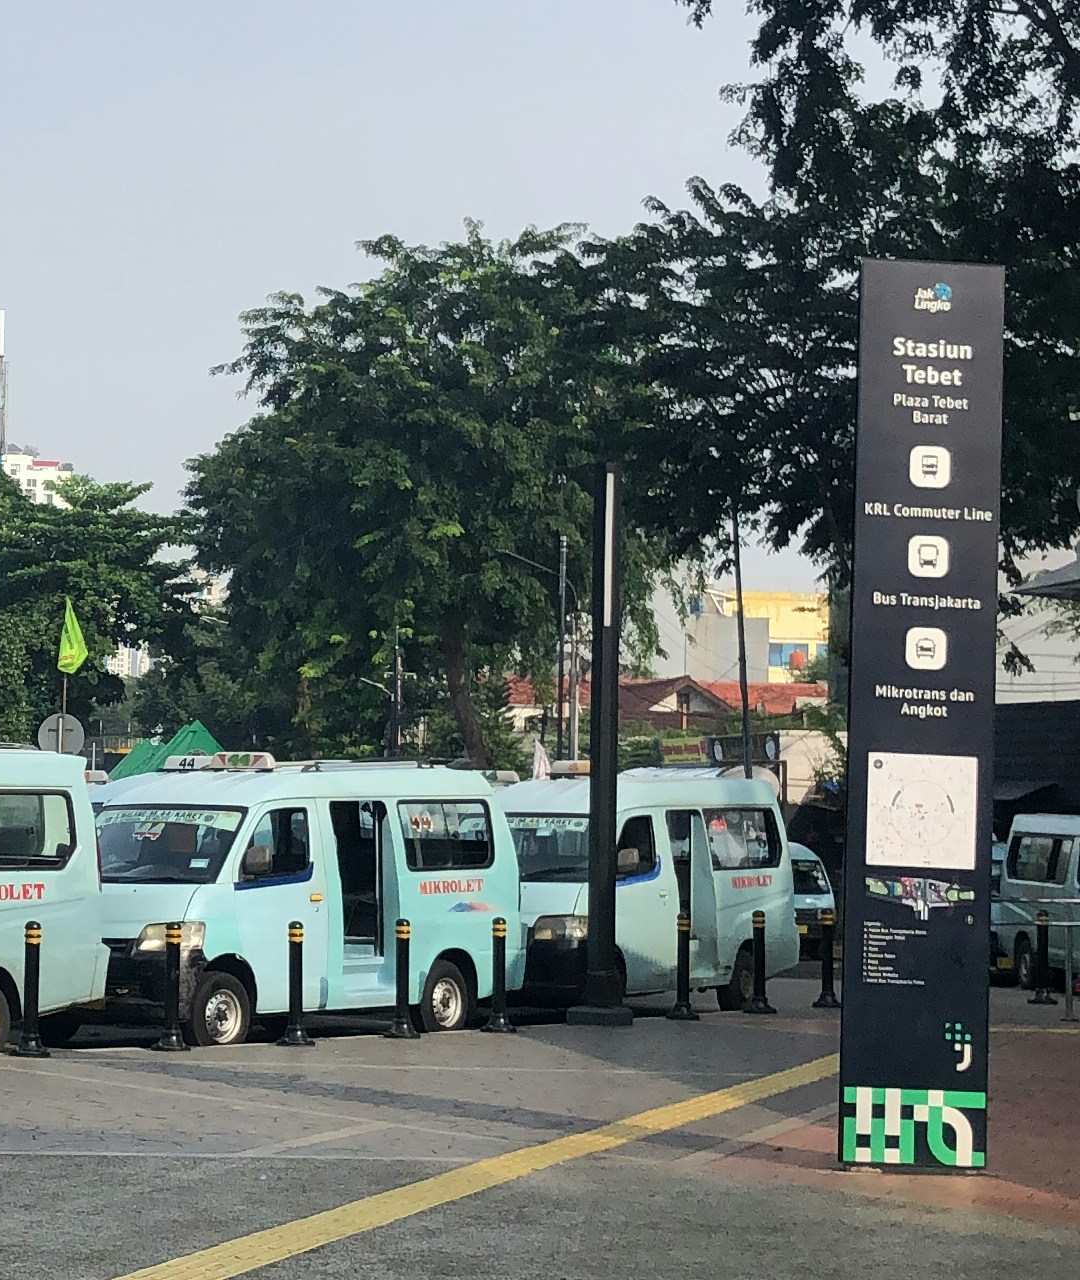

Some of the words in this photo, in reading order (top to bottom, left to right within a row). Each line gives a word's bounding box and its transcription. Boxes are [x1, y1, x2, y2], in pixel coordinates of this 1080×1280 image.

[914, 300, 951, 313] Lingko
[893, 337, 972, 359] Stasiun
[902, 364, 962, 386] Tebet
[894, 393, 929, 407] Plaza
[932, 395, 968, 409] Tebet
[913, 411, 949, 424] Barat
[865, 503, 890, 515] KRL
[894, 504, 961, 519] Commuter
[964, 507, 992, 521] Line
[874, 592, 896, 605] Bus
[900, 593, 981, 610] Transjakarta
[876, 685, 946, 700] Mikrotrans
[950, 689, 974, 701] dan
[901, 703, 947, 718] Angkot
[179, 758, 195, 769] 44
[420, 879, 483, 894] MIKROLET
